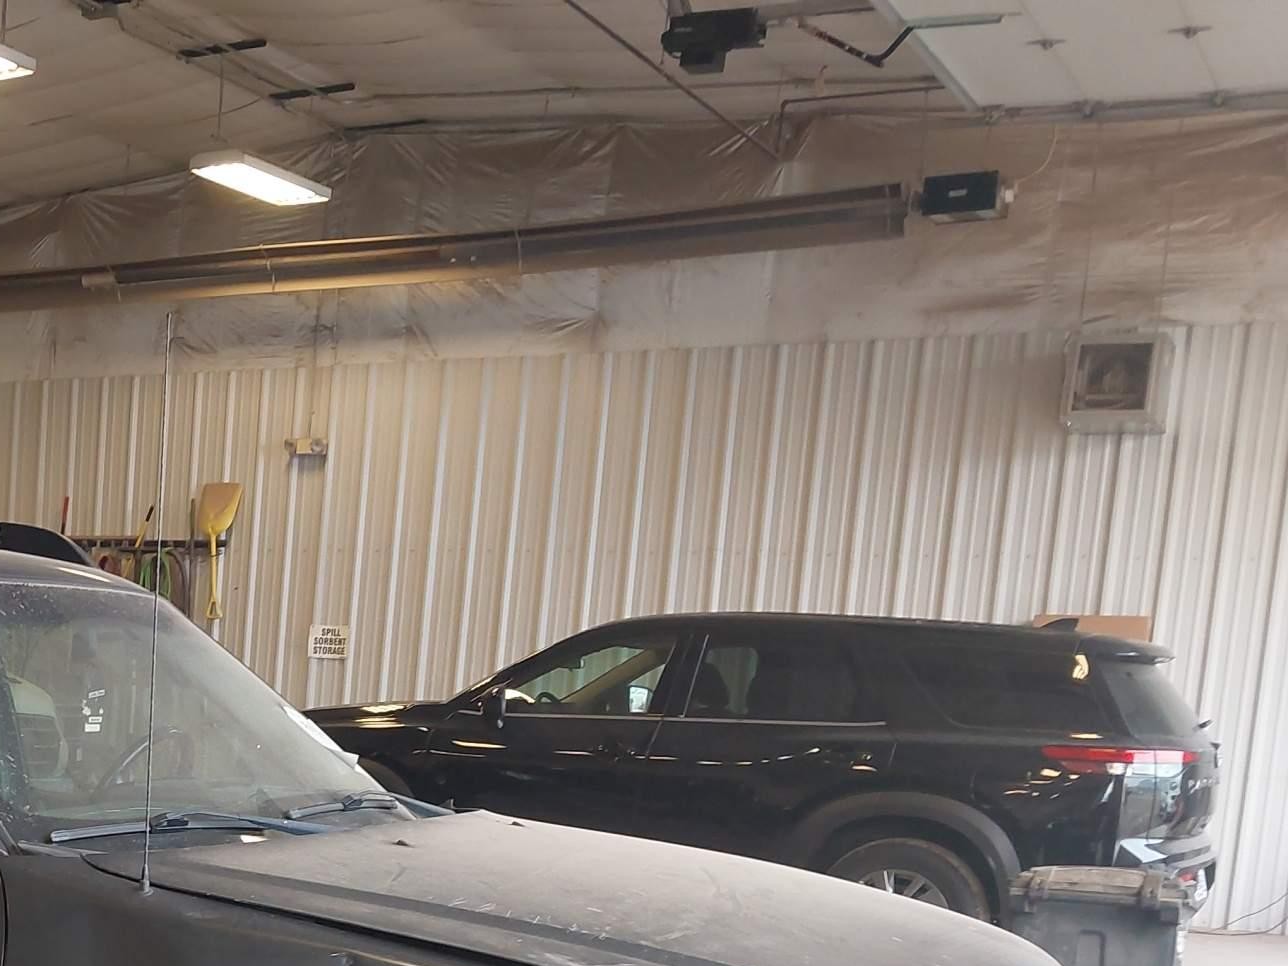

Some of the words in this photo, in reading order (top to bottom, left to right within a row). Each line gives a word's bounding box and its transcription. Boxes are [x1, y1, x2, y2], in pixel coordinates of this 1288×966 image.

[321, 627, 341, 637] SPILL
[313, 637, 347, 646] SORBENT
[313, 646, 346, 655] STORAGE
